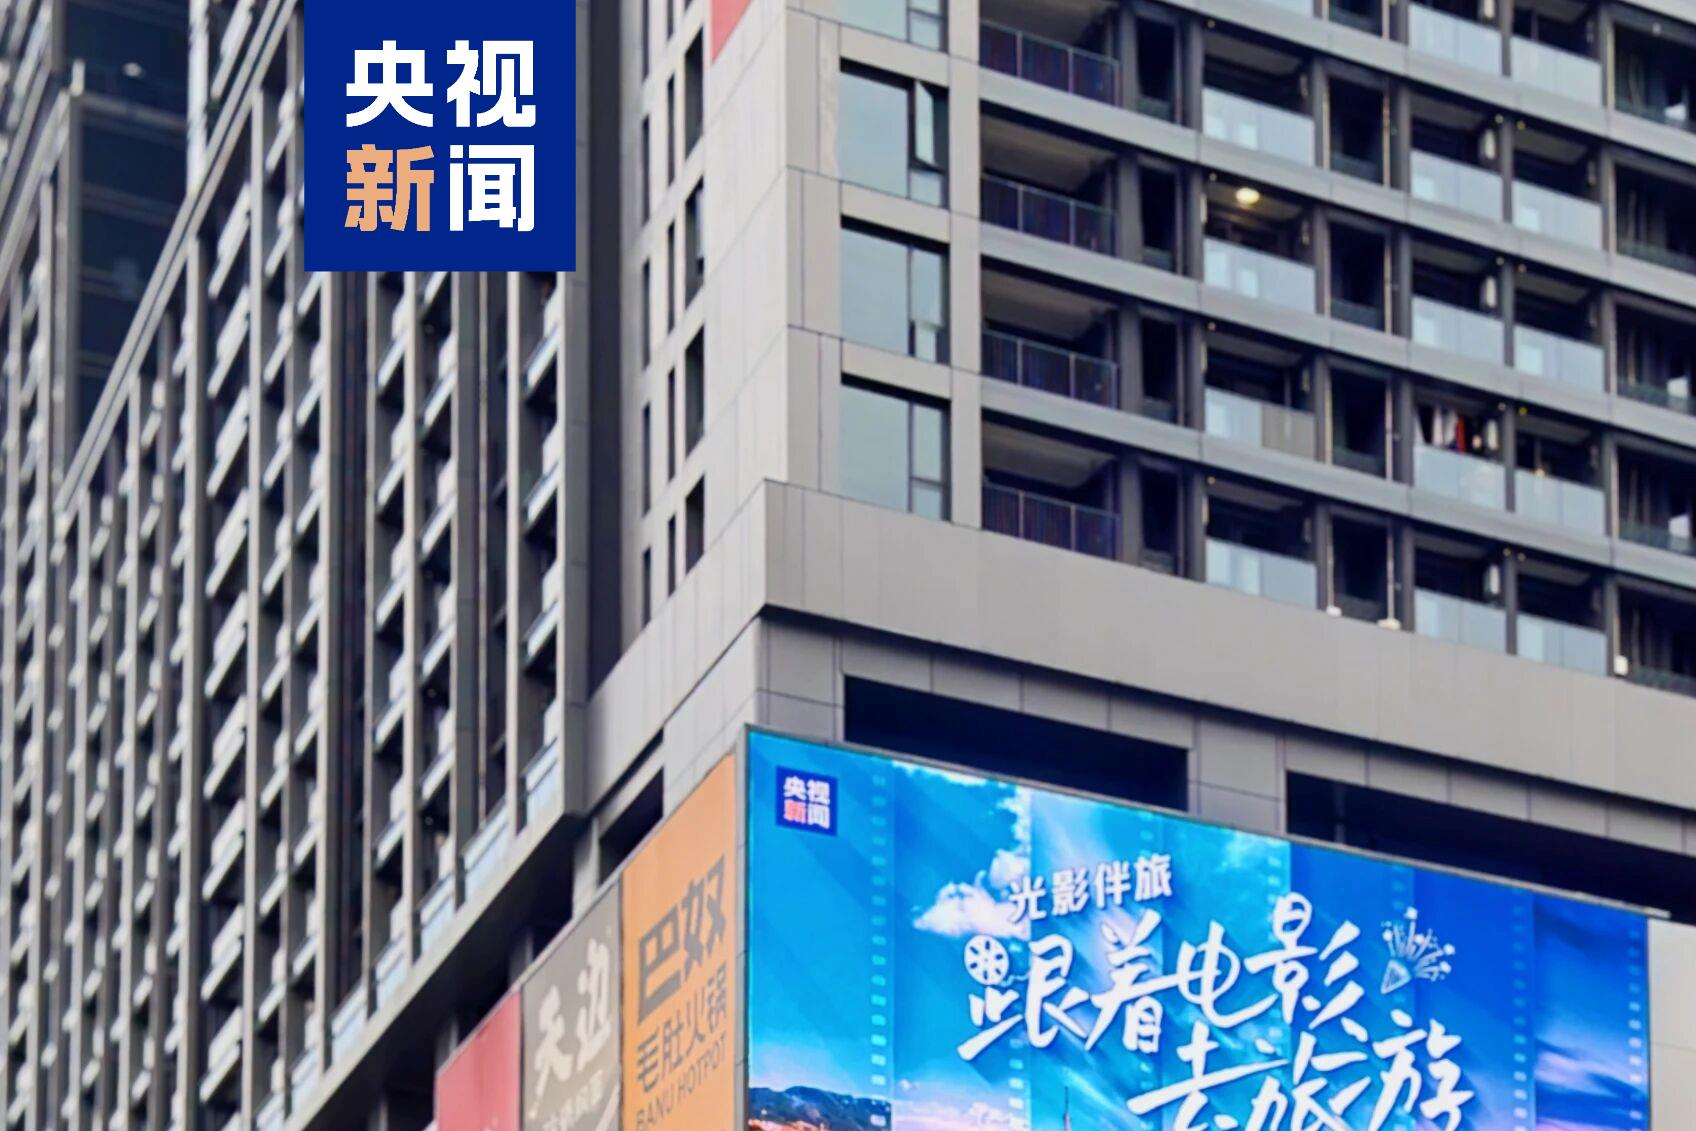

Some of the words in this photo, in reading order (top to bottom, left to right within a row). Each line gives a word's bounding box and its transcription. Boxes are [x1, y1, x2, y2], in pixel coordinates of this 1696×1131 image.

[784, 776, 830, 805] 央视
[784, 799, 830, 829] 新闻
[1008, 853, 1173, 923] 光影伴旅
[638, 853, 726, 1027] 巴奴
[957, 892, 1369, 1062] 跟着电影
[636, 960, 727, 1093] 毛肚火锅
[677, 1030, 727, 1104] HOTPOT
